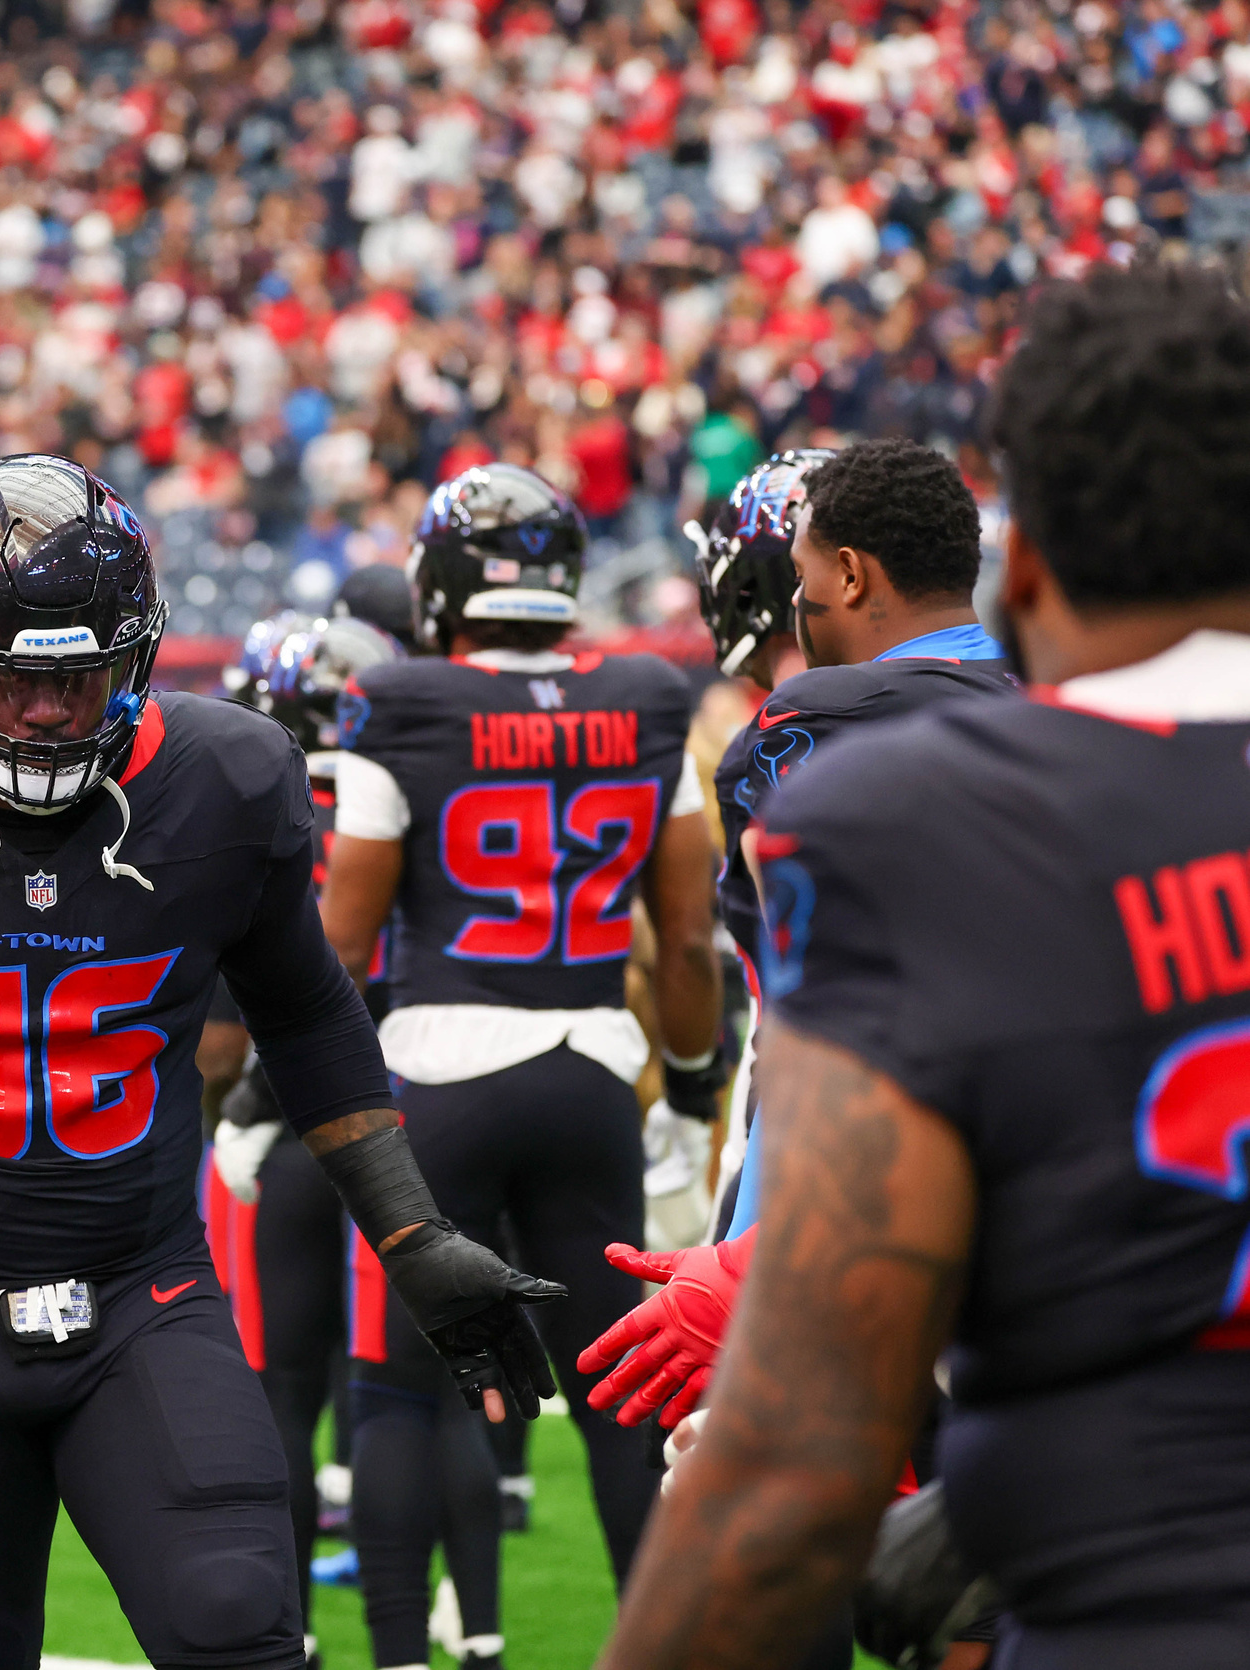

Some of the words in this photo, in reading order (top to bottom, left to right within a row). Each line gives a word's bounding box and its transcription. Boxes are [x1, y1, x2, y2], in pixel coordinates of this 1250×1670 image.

[22, 633, 89, 647] TEXANS
[470, 709, 639, 770] HORTON
[30, 888, 53, 905] NFL
[440, 776, 662, 966] 92
[1112, 848, 1250, 1015] HO
